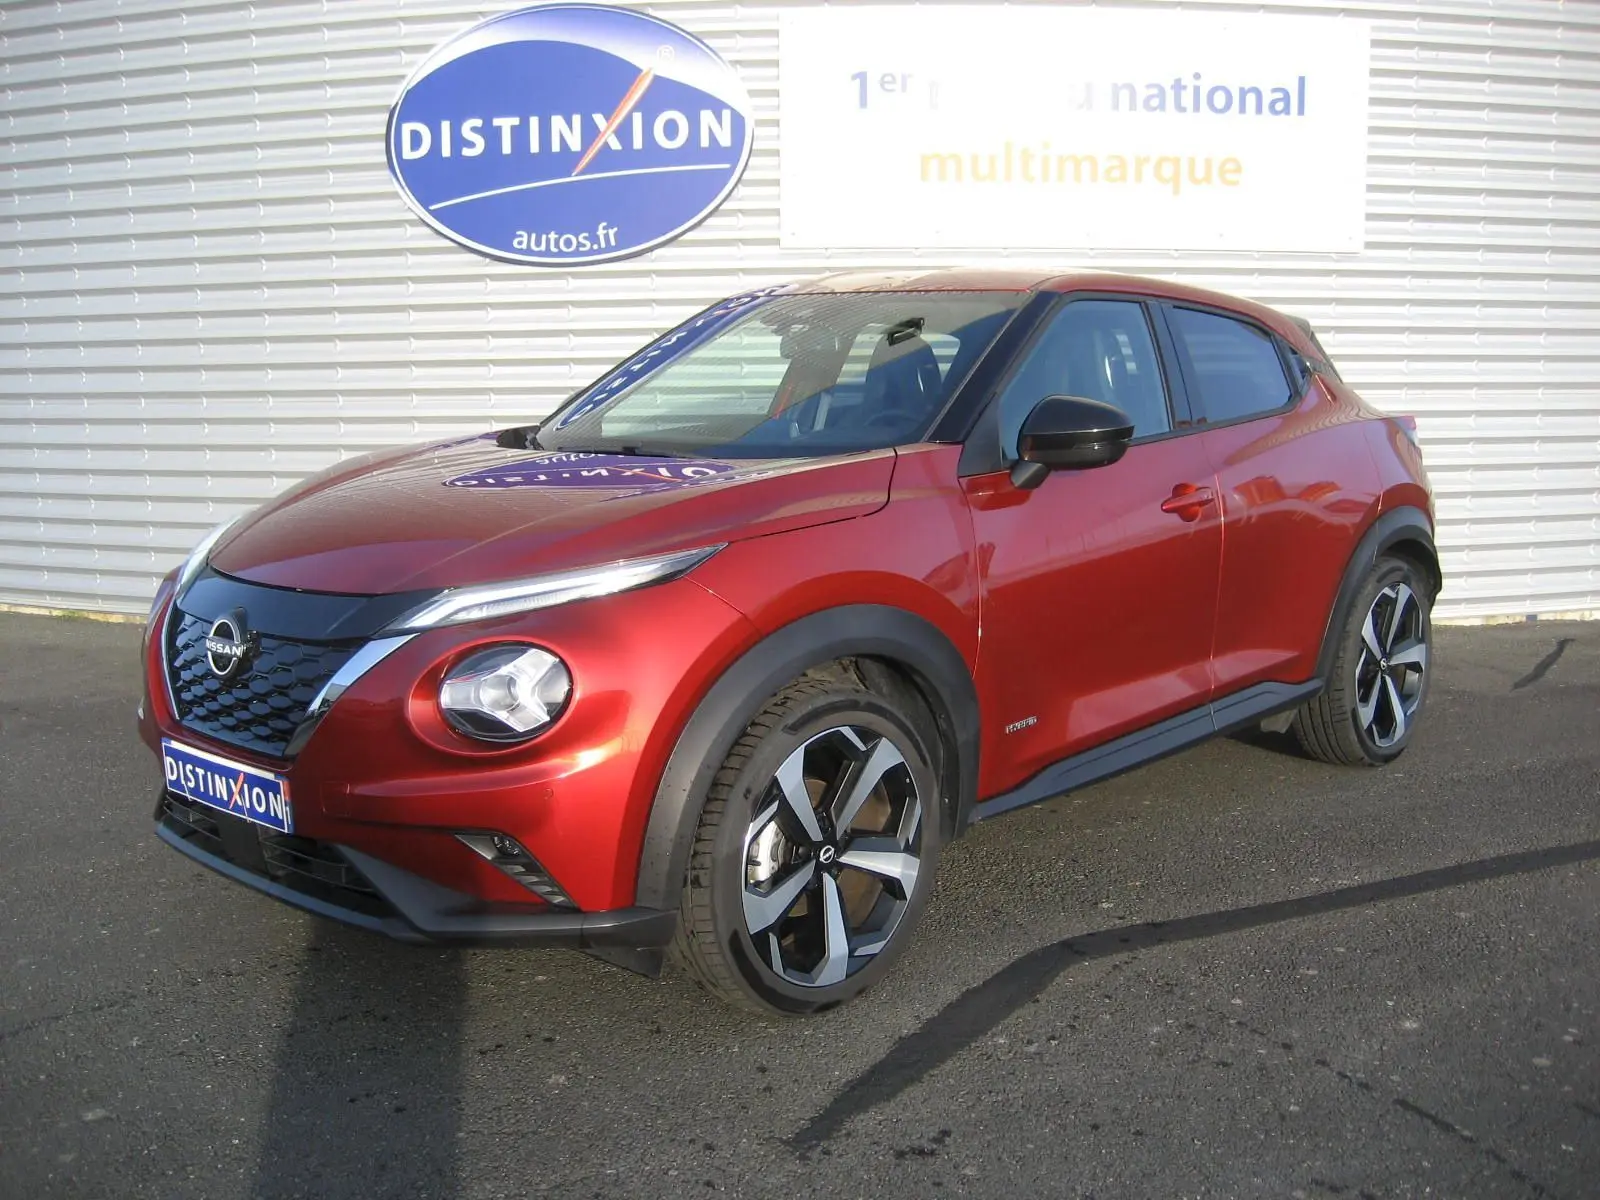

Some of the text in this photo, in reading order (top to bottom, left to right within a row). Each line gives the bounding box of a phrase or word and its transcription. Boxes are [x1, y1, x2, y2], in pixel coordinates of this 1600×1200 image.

[850, 71, 913, 110] 1er
[1110, 72, 1307, 117] national
[401, 100, 732, 168] DISTINXION
[919, 141, 1243, 196] multimarque
[512, 222, 619, 253] autos.fr
[206, 638, 243, 656] NISSAN
[166, 757, 283, 820] DISTINXION
